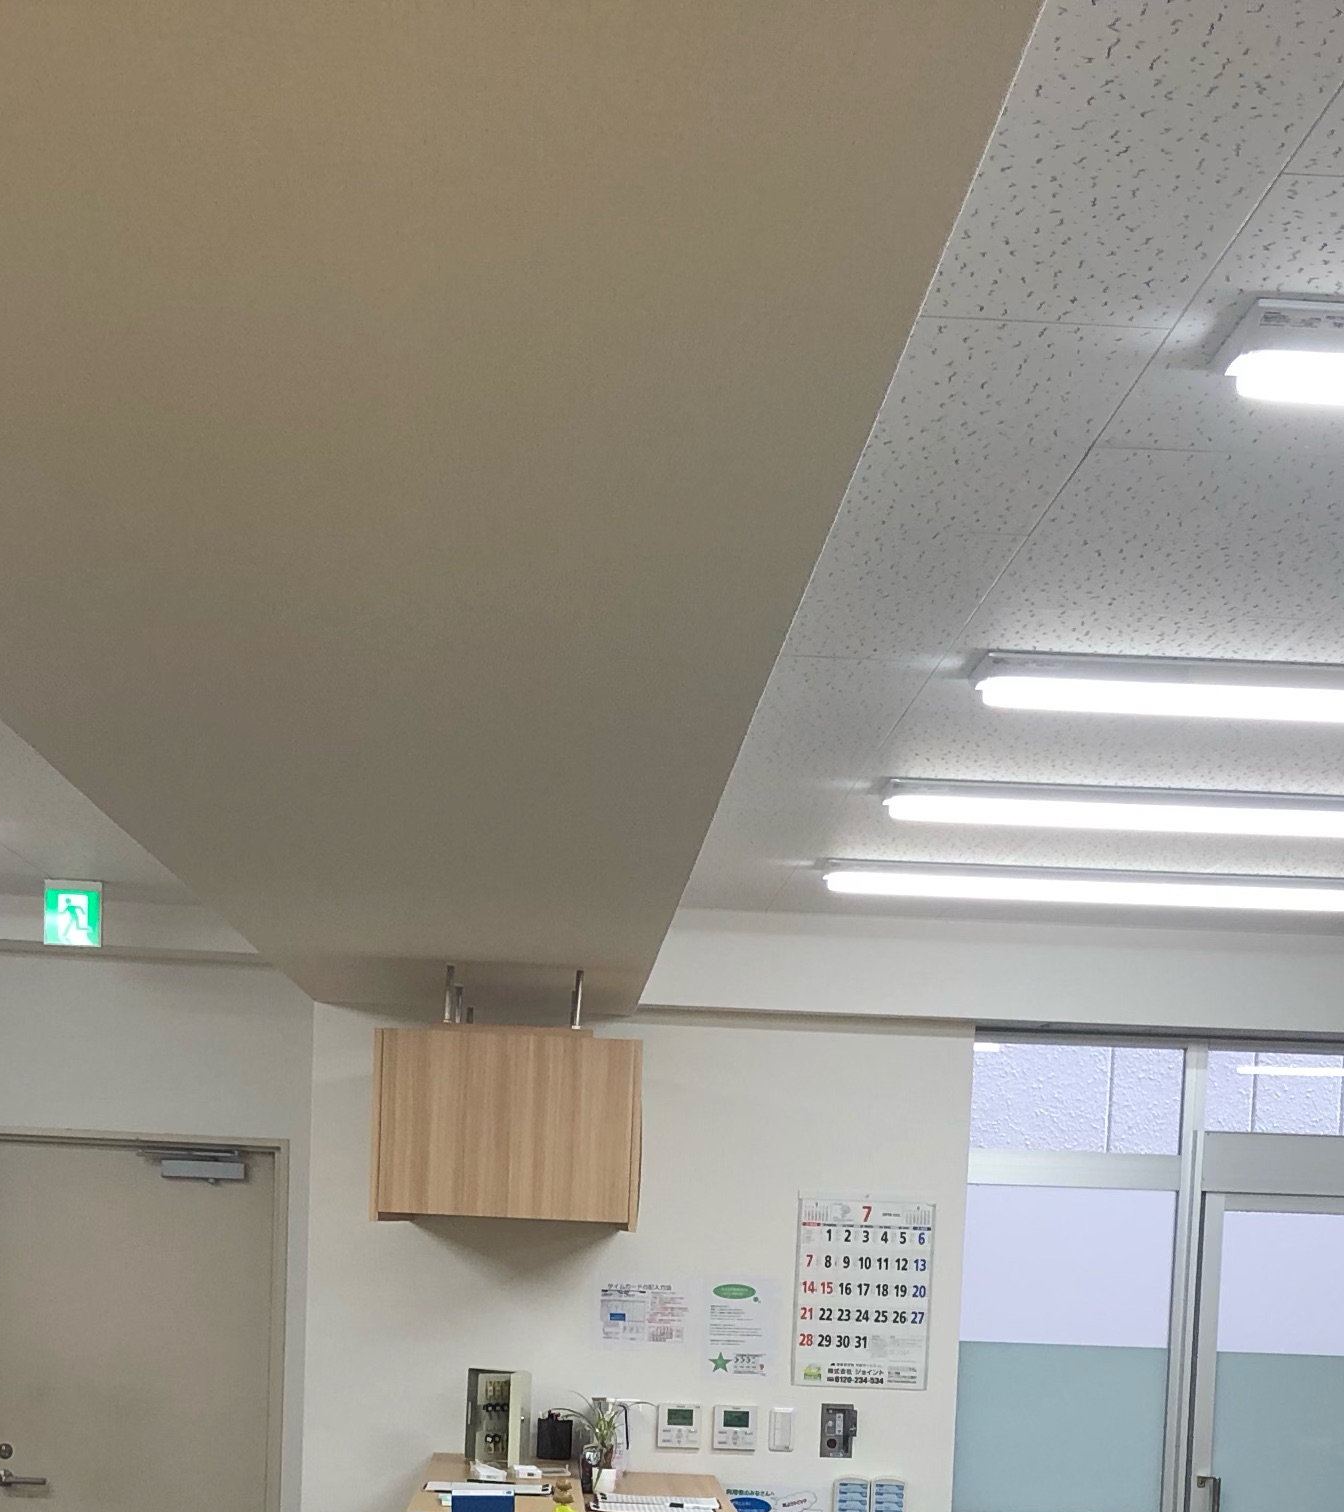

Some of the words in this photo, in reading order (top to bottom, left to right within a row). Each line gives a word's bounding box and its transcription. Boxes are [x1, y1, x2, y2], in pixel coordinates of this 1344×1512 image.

[862, 1205, 873, 1223] 7
[826, 1229, 832, 1242] 1
[844, 1230, 852, 1243] 2
[862, 1231, 870, 1243] 3
[880, 1231, 889, 1244] 4
[899, 1232, 907, 1245] 5
[918, 1232, 926, 1246] 6
[806, 1255, 814, 1268] 7
[824, 1255, 832, 1269] 8
[842, 1256, 851, 1269] 9
[858, 1257, 872, 1270] 10
[876, 1258, 889, 1271] 11
[894, 1258, 909, 1272] 12
[913, 1259, 927, 1272] 13
[802, 1281, 817, 1294] 14
[820, 1282, 834, 1295] 15
[838, 1283, 852, 1296] 16
[856, 1283, 871, 1297] 17
[875, 1284, 889, 1297] 18
[893, 1285, 908, 1298] 19
[911, 1285, 927, 1299] 20
[800, 1307, 813, 1321] 21
[818, 1308, 833, 1322] 22
[836, 1309, 852, 1322] 23
[854, 1309, 870, 1323] 24
[873, 1310, 888, 1324] 25
[892, 1311, 907, 1324] 26
[910, 1311, 925, 1325] 27
[798, 1334, 814, 1347] 28
[817, 1334, 832, 1348] 29
[835, 1335, 851, 1349] 30
[854, 1336, 868, 1349] 31
